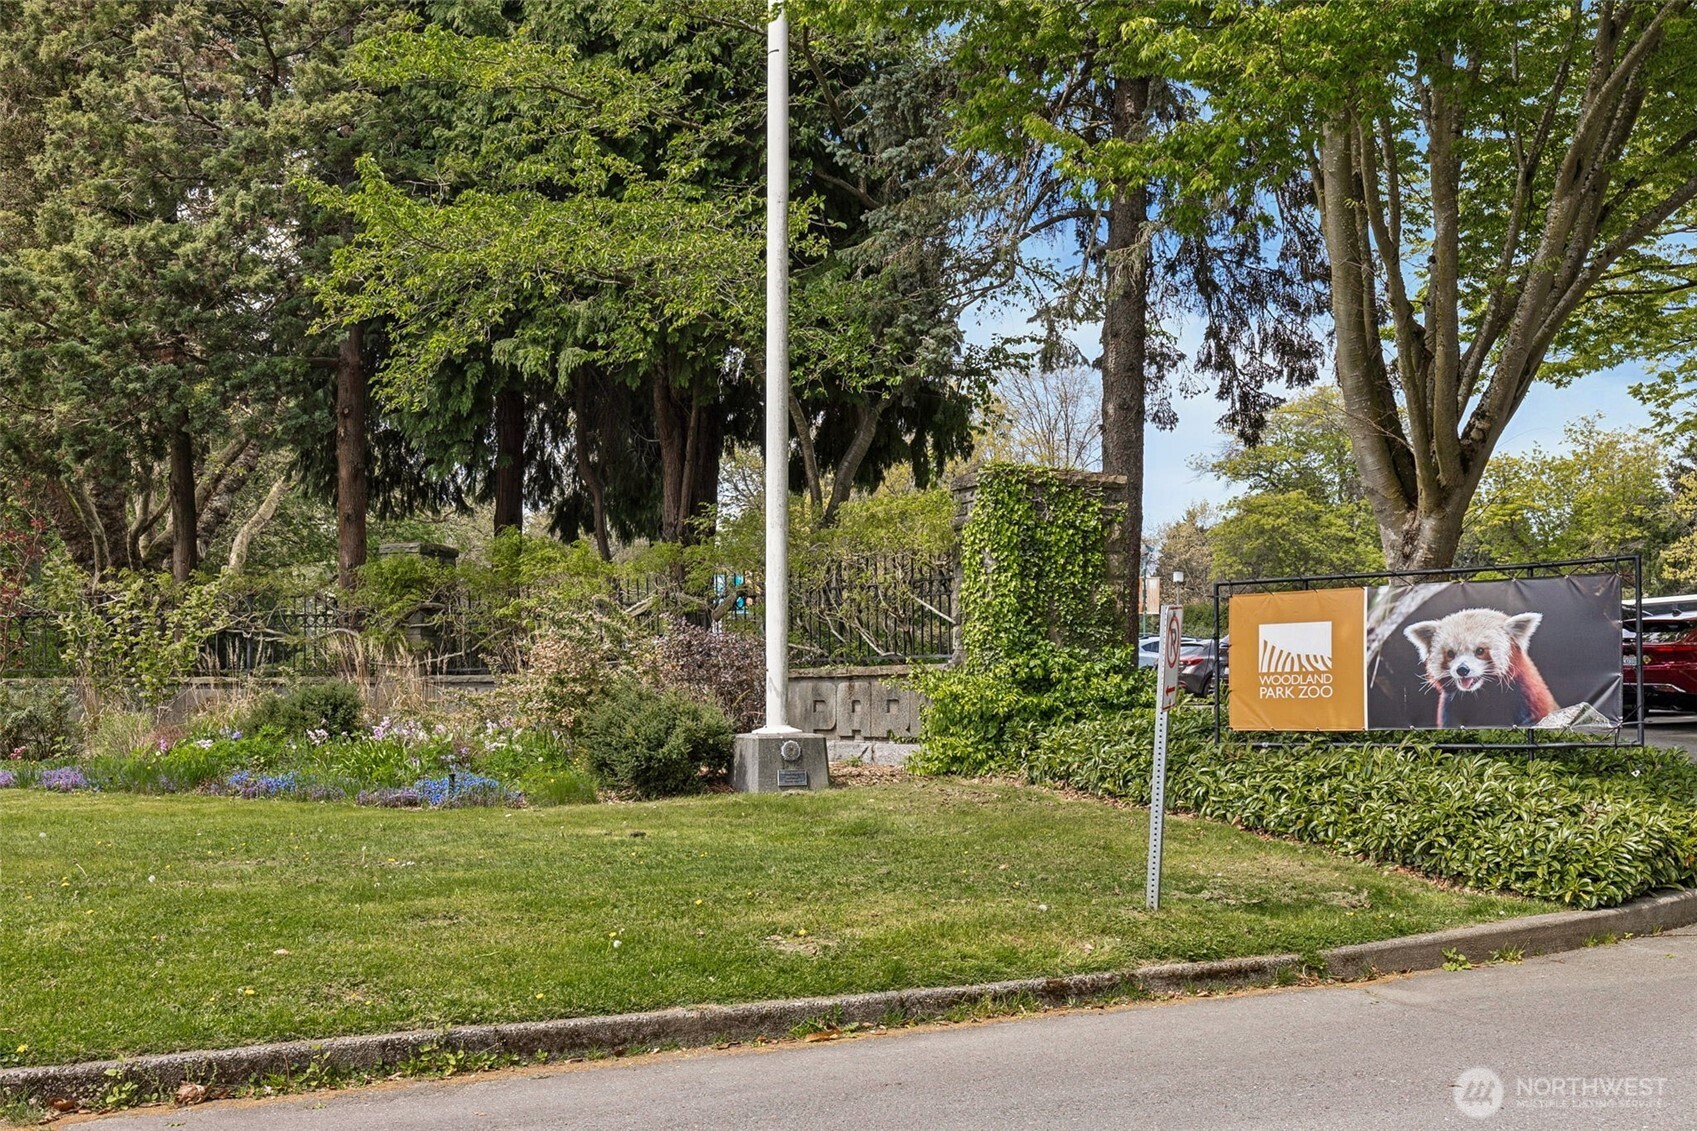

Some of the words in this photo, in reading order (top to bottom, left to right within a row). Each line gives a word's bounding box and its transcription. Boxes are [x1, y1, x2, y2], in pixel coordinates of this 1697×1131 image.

[1258, 673, 1333, 685] WOODLAND
[1259, 686, 1295, 699] PARK
[1298, 685, 1333, 699] ZOO
